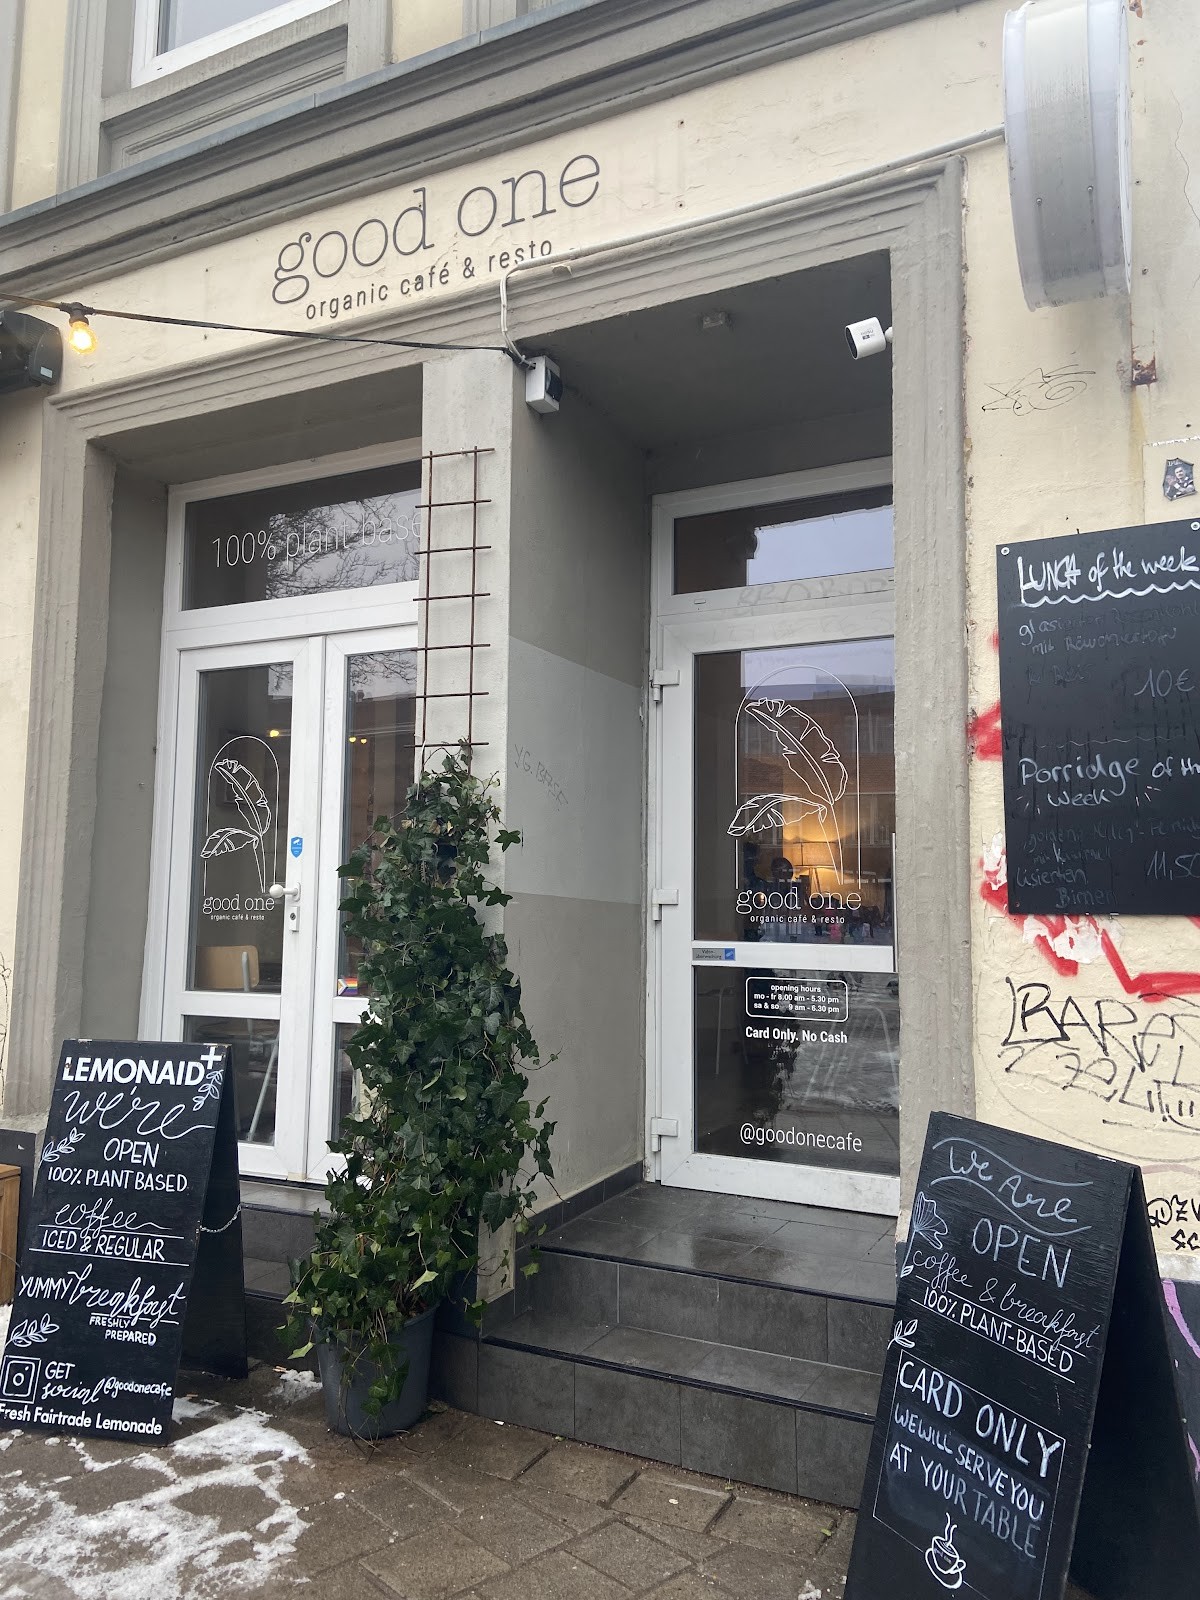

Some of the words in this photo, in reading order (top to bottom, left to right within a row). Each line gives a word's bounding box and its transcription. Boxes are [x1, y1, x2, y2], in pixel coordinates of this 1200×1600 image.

[272, 187, 434, 304] good
[457, 154, 600, 237] one
[306, 283, 388, 319] organic
[400, 262, 449, 295] café
[462, 257, 475, 278] &
[488, 240, 552, 272] resto
[212, 530, 277, 568] 100%
[1017, 553, 1081, 597] LUNCH
[1088, 552, 1108, 592] of
[1113, 547, 1137, 580] the
[1141, 546, 1200, 575] week
[1019, 754, 1140, 797] Porridge
[1151, 756, 1173, 778] of
[1181, 757, 1200, 776] th
[202, 893, 240, 914] good
[244, 897, 275, 911] one
[210, 914, 230, 922] organic
[231, 913, 243, 921] café
[245, 913, 249, 921] &
[736, 887, 801, 915] good
[809, 891, 862, 911] one
[750, 915, 784, 925] organic
[787, 914, 808, 924] café
[811, 915, 817, 923] &
[820, 915, 845, 924] resto
[770, 985, 798, 994] opening
[800, 985, 821, 993] hours
[745, 1026, 770, 1039] Card
[772, 1027, 799, 1043] Only.
[802, 1030, 817, 1042] No
[820, 1030, 848, 1043] Cash
[104, 1137, 159, 1167] OPEN
[740, 1122, 862, 1152] @goodonecafe
[47, 1166, 82, 1186] 100%
[85, 1169, 134, 1189] PLANT
[134, 1172, 188, 1192] BASED
[950, 1146, 993, 1181] We
[998, 1175, 1078, 1223] Are
[55, 1197, 172, 1239] coffee
[42, 1229, 77, 1251] ICED
[79, 1236, 92, 1253] &
[95, 1234, 165, 1262] REGULAR
[972, 1217, 1072, 1288] OPEN
[18, 1275, 73, 1300] YUMMY
[68, 1263, 186, 1328] breakfast
[912, 1250, 973, 1291] coffee
[978, 1278, 998, 1303] &
[1000, 1283, 1101, 1350] breakfast
[89, 1315, 132, 1328] FRESHLY
[104, 1330, 157, 1346] PREPARED
[923, 1287, 956, 1319] 100%
[960, 1304, 1074, 1373] PLANT-BASED
[44, 1361, 76, 1380] GET
[41, 1377, 105, 1405] social
[103, 1376, 173, 1399] @goodonecafe
[0, 1403, 31, 1422] Fresh
[33, 1407, 92, 1428] Fairtrade
[95, 1413, 163, 1436] Lemonade
[899, 1360, 963, 1418] CARD
[975, 1404, 1062, 1478] ONLY
[889, 1442, 913, 1473] AT
[920, 1456, 967, 1516] YOUR
[972, 1488, 1041, 1559] TABLE
